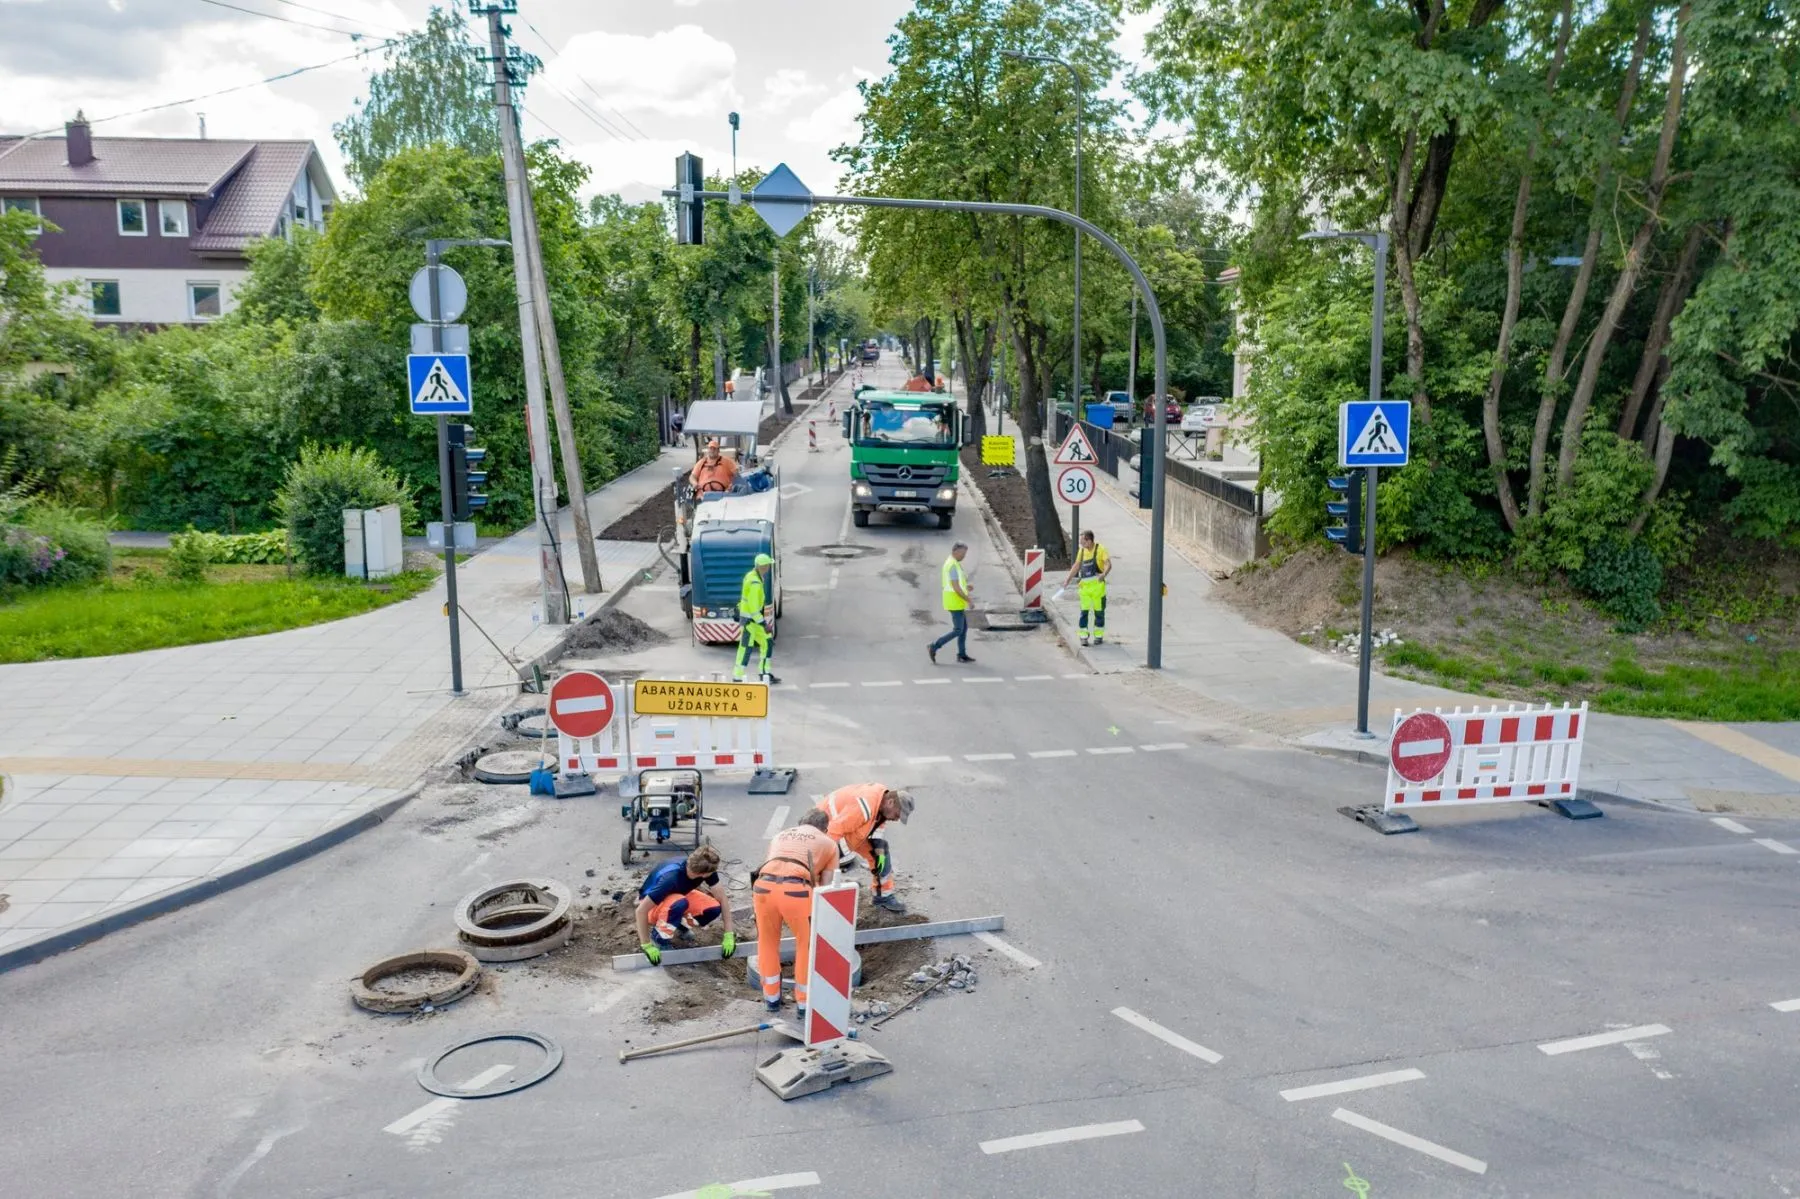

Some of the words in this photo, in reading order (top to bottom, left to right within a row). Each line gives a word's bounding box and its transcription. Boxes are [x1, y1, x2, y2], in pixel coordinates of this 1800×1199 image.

[1066, 478, 1087, 493] 30
[745, 690, 757, 701] g.
[668, 699, 738, 712] UŽDARYTA
